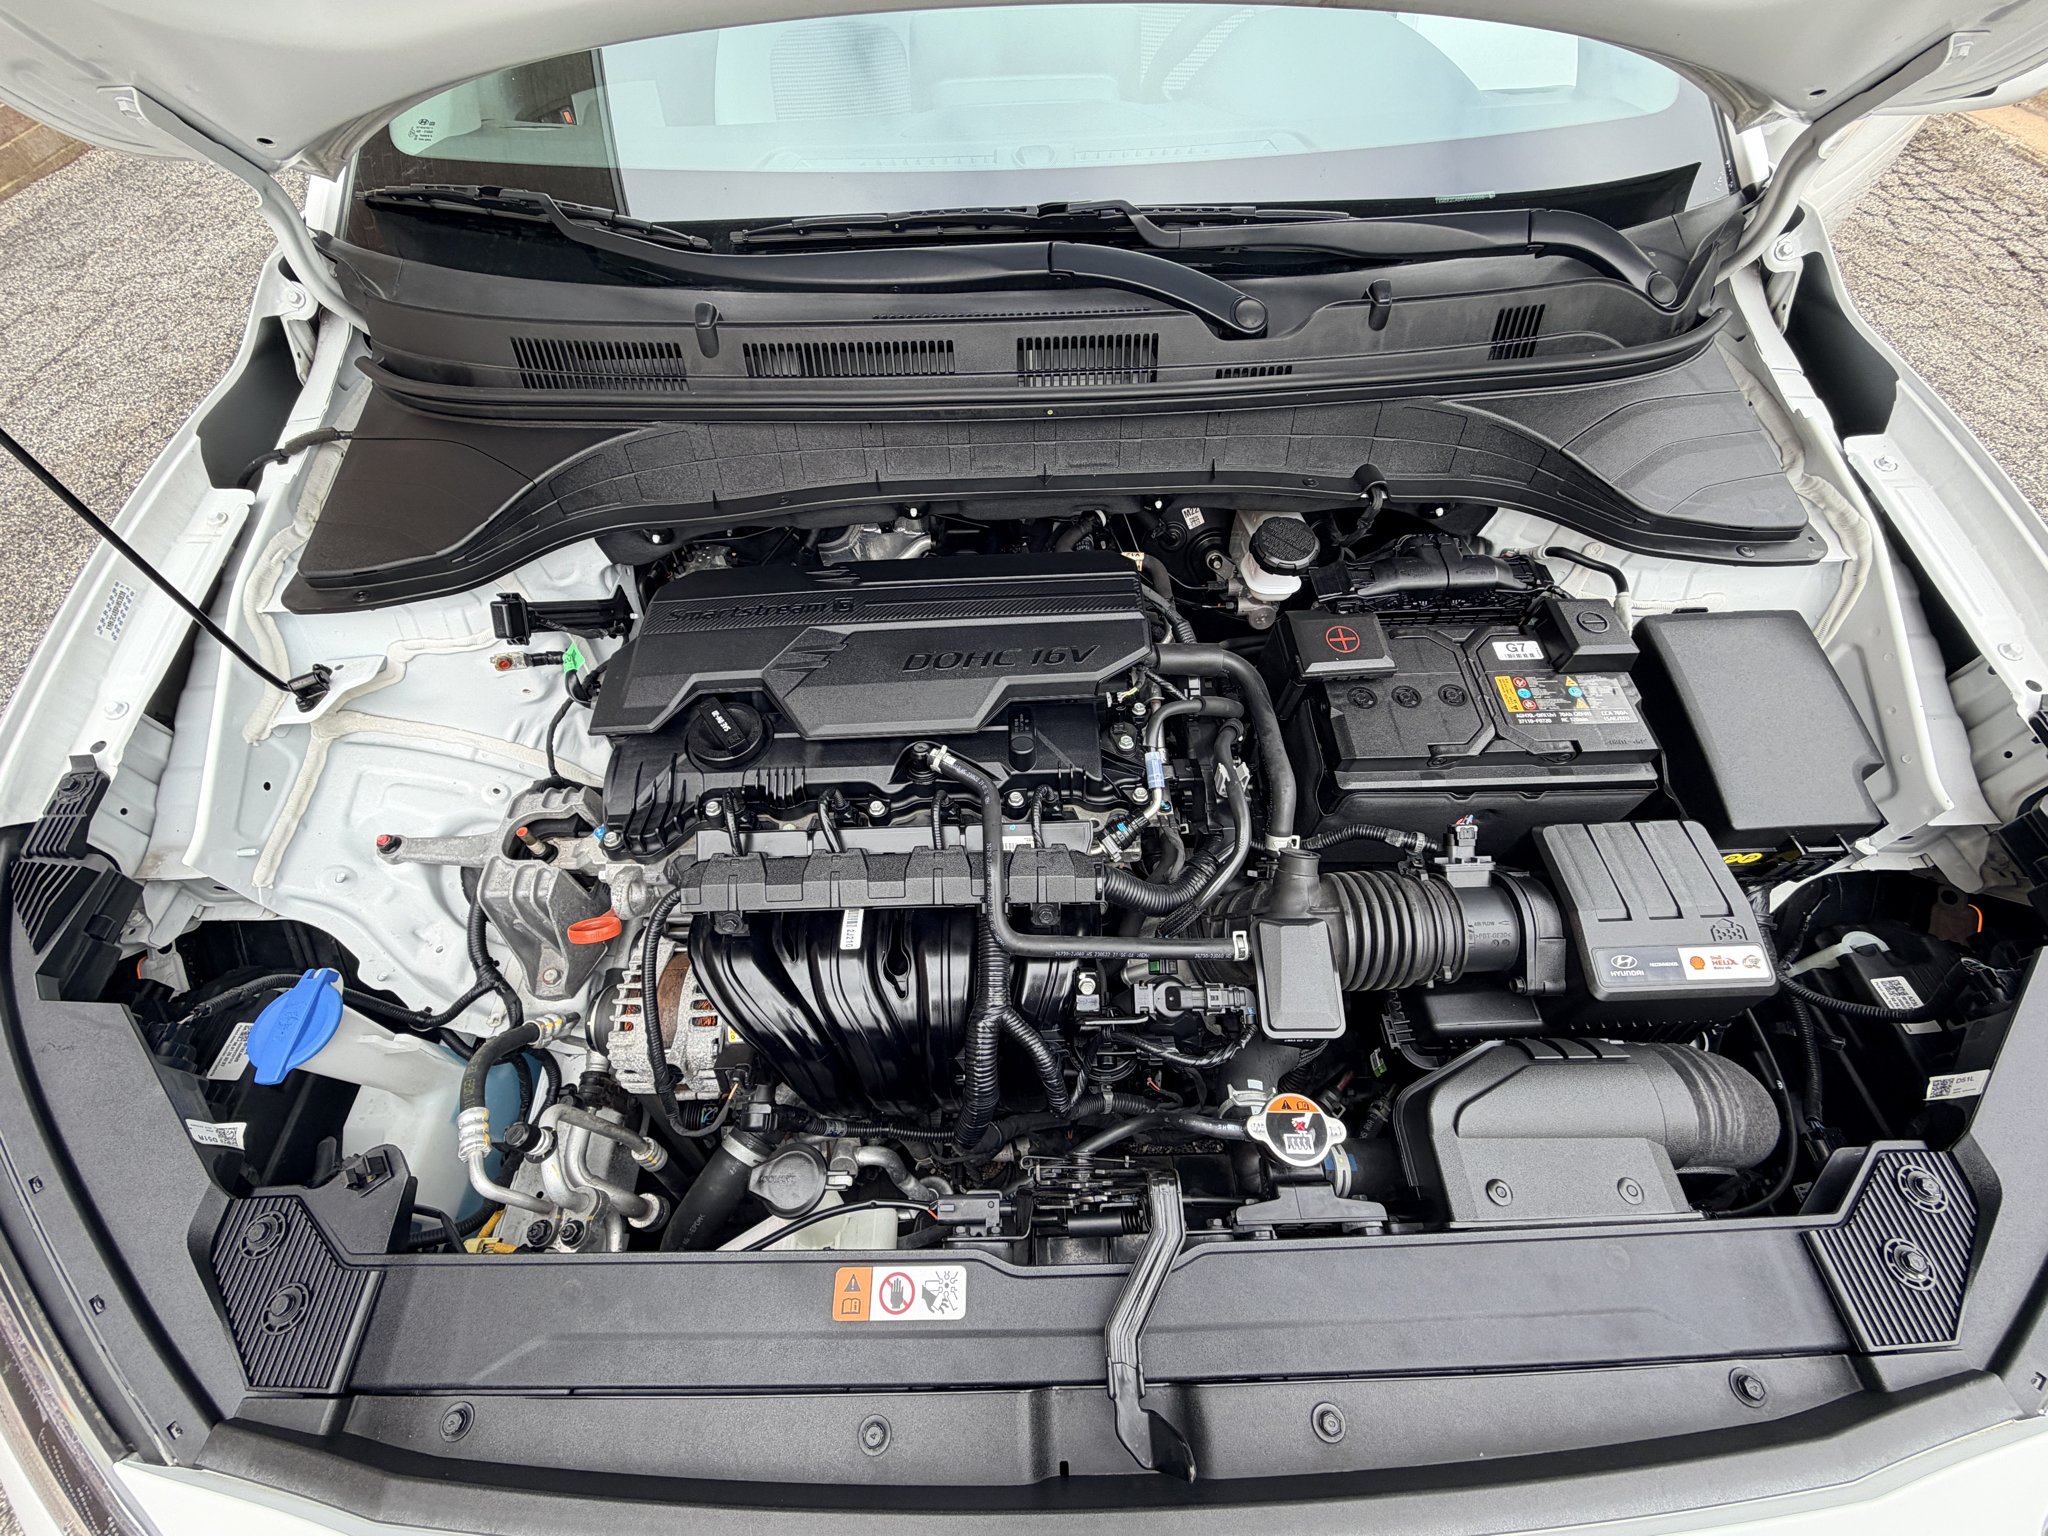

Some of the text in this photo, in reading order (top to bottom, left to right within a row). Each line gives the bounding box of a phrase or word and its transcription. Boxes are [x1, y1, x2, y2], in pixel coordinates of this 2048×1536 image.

[1183, 507, 1200, 518] M22
[665, 601, 827, 622] Smartstream
[1505, 642, 1526, 653] G7
[902, 645, 1101, 673] DOHC 16V
[1711, 958, 1739, 967] HELIX
